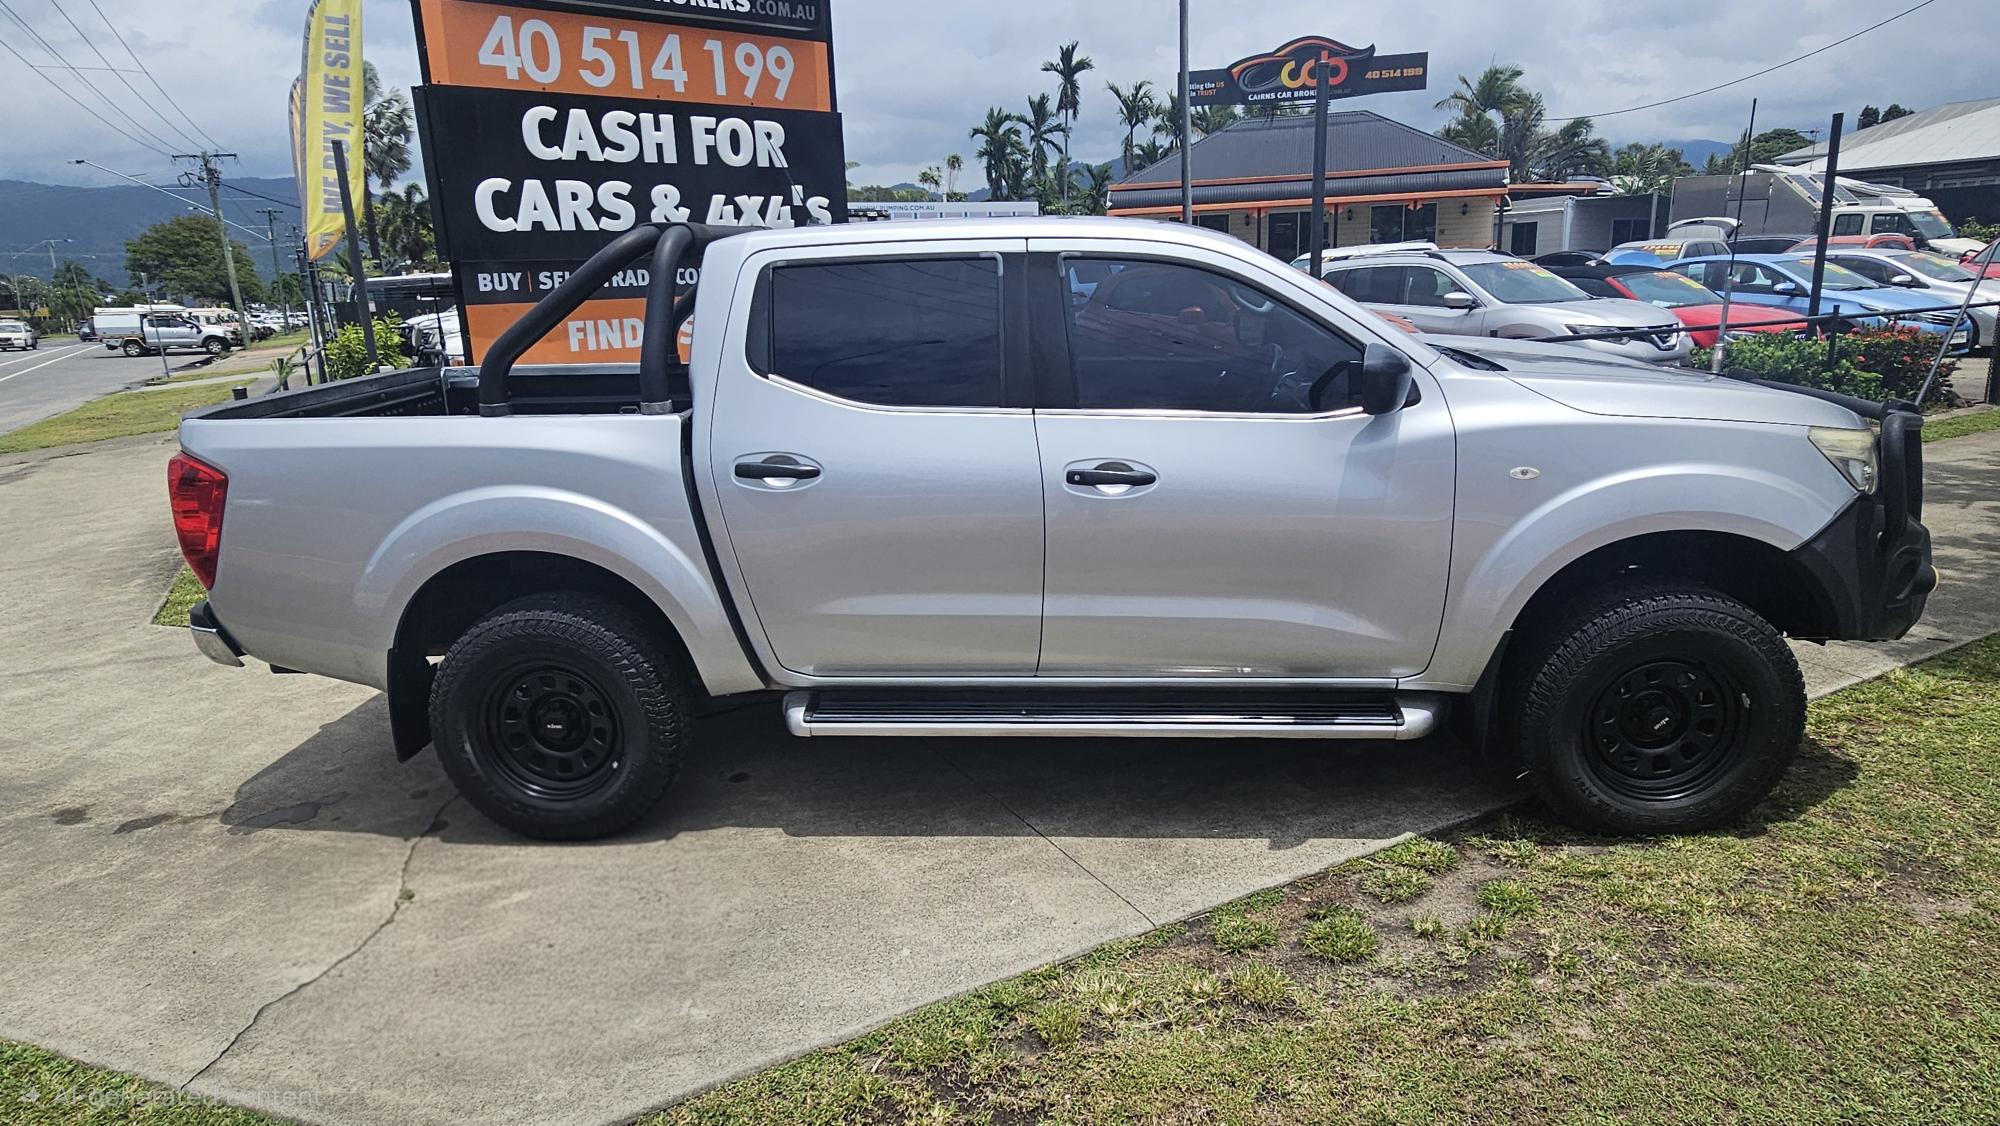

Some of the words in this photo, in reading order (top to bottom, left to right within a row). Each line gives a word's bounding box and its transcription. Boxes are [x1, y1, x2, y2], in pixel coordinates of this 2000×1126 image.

[324, 14, 351, 69] SELL
[478, 15, 562, 84] 40
[579, 26, 688, 94] 514
[703, 39, 795, 102] 199
[1205, 81, 1215, 89] the
[1382, 69, 1402, 78] 514
[322, 73, 351, 113] WE
[1248, 92, 1276, 101] CAIRNS
[1277, 91, 1292, 99] CAR
[1294, 90, 1317, 98] BROK
[522, 105, 678, 164] CASH
[690, 116, 788, 168] FOR
[474, 177, 636, 232] CARS
[651, 184, 691, 223] &
[706, 185, 832, 227] 4X4'S
[477, 272, 522, 292] BUY
[567, 318, 645, 352] FIND
